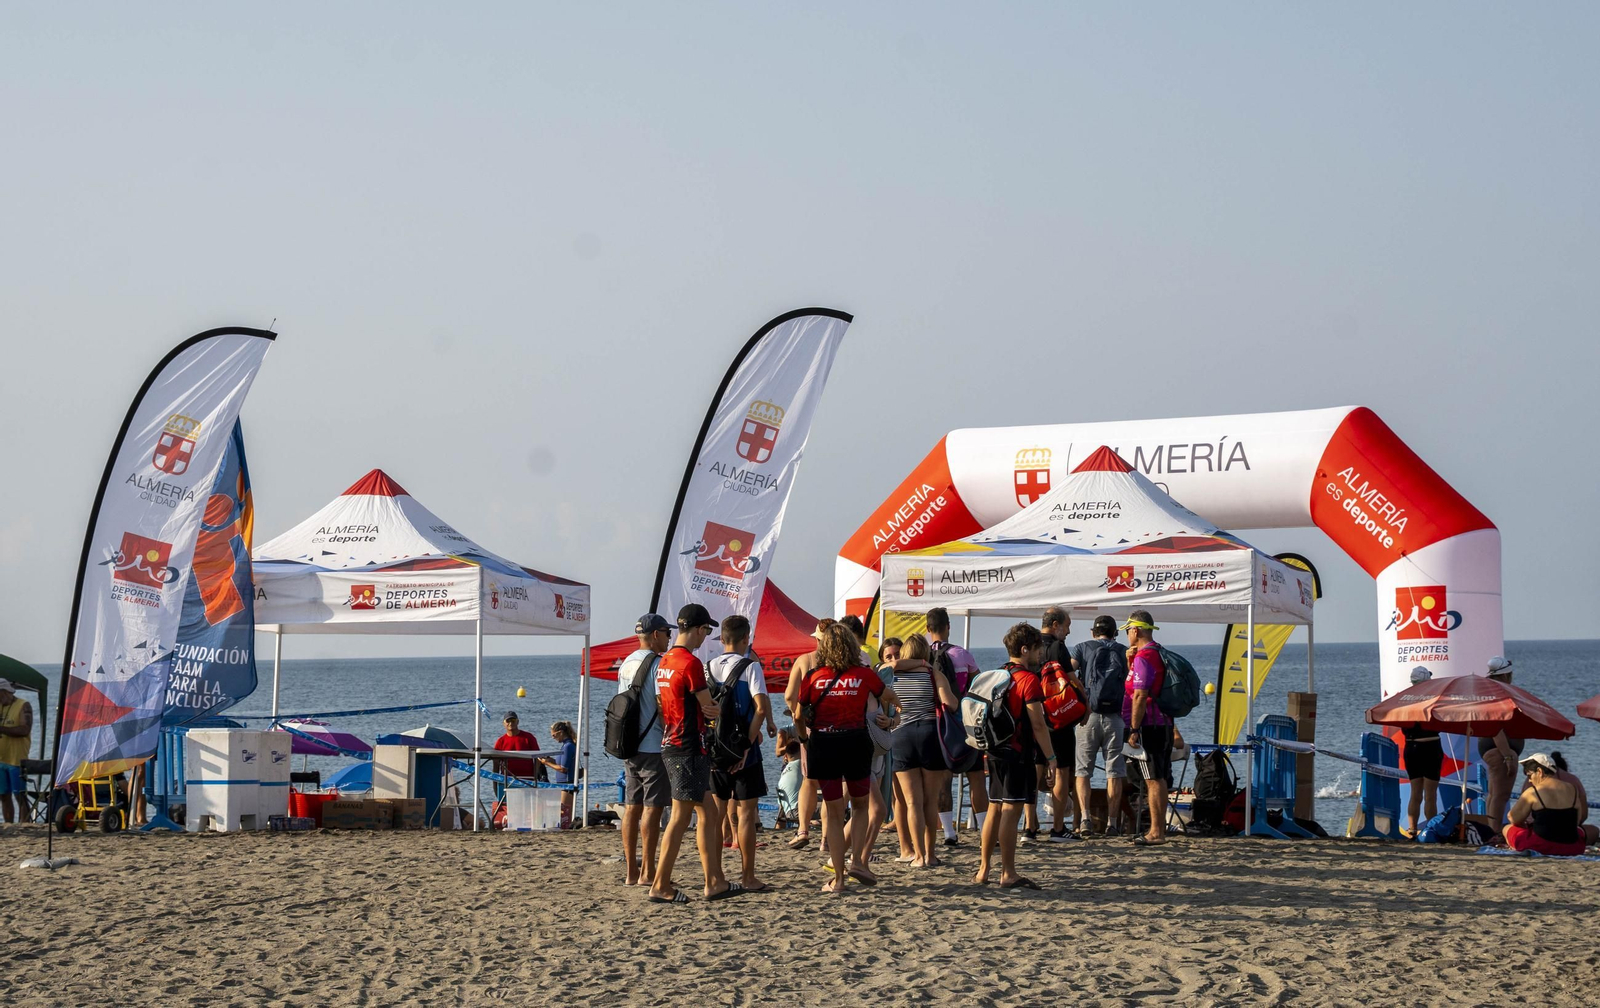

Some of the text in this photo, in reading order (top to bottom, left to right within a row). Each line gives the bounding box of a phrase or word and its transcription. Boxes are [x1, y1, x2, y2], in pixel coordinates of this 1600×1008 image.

[1114, 435, 1251, 475] MERÍA
[709, 461, 778, 492] ALMERÍA
[125, 473, 194, 502] ALMERÍA
[724, 480, 760, 496] CIUDAD
[140, 492, 176, 508] CIUDAD
[1052, 500, 1122, 512] ALMERÍA
[1337, 466, 1408, 534] ALMERÍA
[872, 483, 935, 550] ALMERÍA
[899, 495, 947, 546] deporte
[1068, 512, 1120, 521] deporte
[1326, 482, 1394, 548] es deporte
[316, 524, 379, 535] ALMERÍA
[328, 535, 377, 544] deporte
[940, 566, 1015, 584] ALMERÍA
[1146, 570, 1217, 582] DEPORTES
[690, 583, 740, 600] DE ALMERIA
[692, 576, 742, 592] DEPORTES
[940, 586, 978, 595] CIUDAD
[1146, 580, 1226, 592] DE ALMERIA
[110, 592, 160, 608] DE ALMERIA
[112, 586, 161, 602] DEPORTES
[386, 589, 448, 600] DEPORTES
[386, 598, 456, 610] DE ALMERIA
[174, 643, 250, 664] FUNDACIÓN
[1398, 645, 1448, 654] DEPORTES
[1410, 654, 1449, 662] ALMERIA
[203, 680, 221, 695] LA
